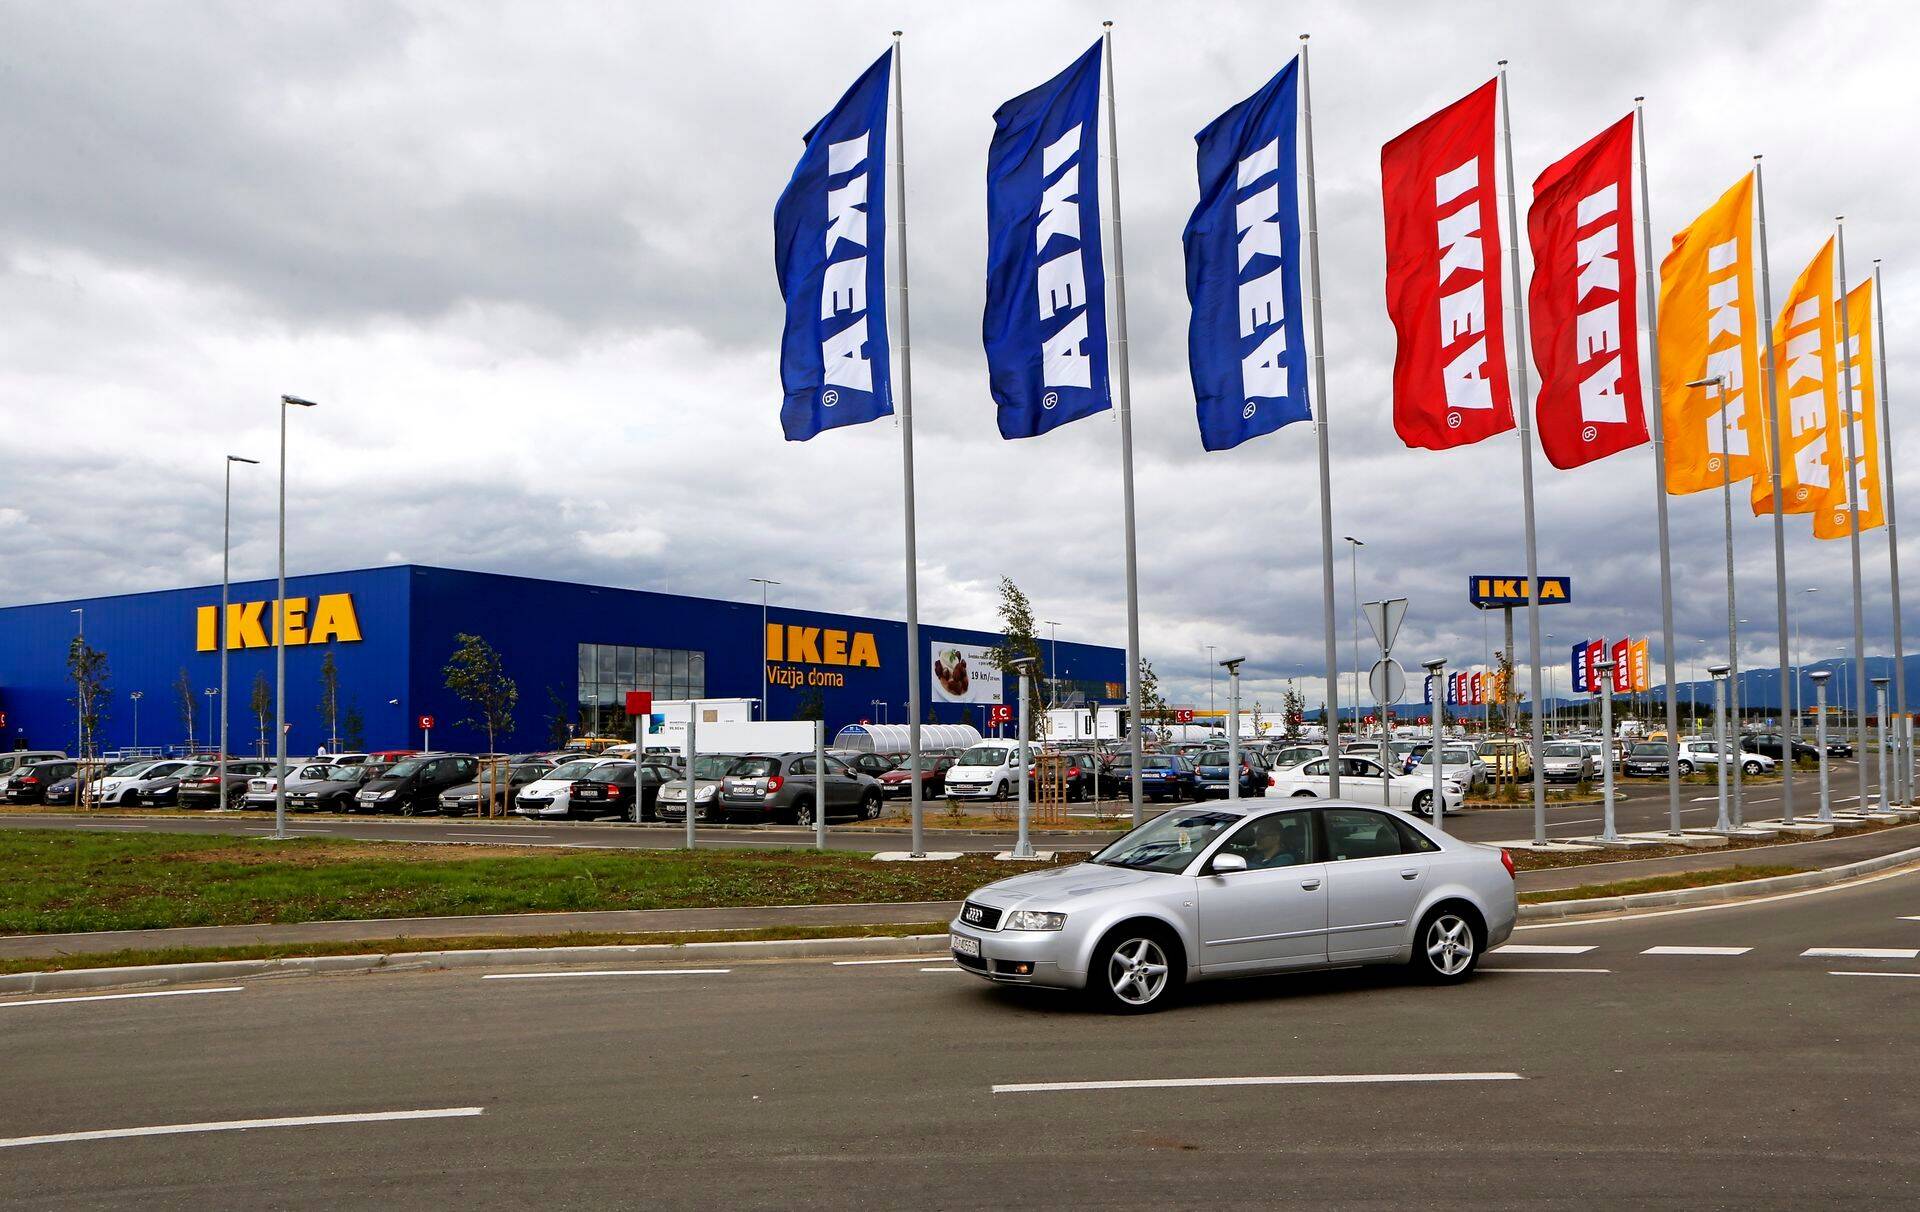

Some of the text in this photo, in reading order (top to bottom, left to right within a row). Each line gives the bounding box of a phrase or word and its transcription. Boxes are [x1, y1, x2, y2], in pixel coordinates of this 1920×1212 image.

[196, 593, 363, 652] IKEA
[766, 623, 880, 668] IKEA
[766, 665, 844, 689] Vizija doma
[422, 717, 430, 725] C
[999, 707, 1007, 717] C
